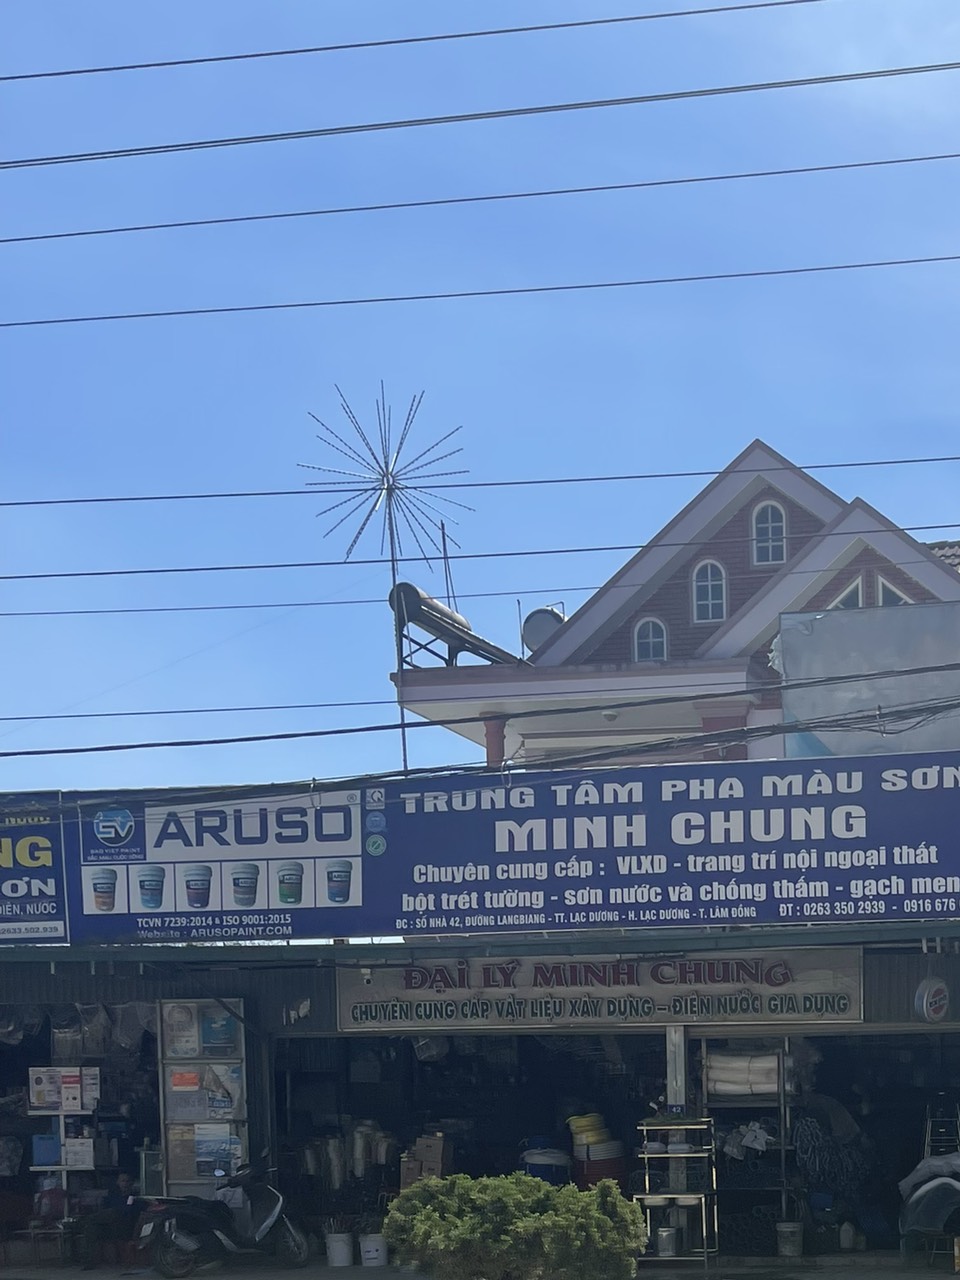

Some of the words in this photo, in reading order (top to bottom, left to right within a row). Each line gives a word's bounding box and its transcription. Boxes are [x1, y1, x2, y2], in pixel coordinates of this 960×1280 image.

[401, 787, 535, 814] TRUNG
[551, 780, 644, 806] TÂM
[662, 777, 744, 801] PHA
[763, 769, 863, 797] MÀU
[153, 806, 353, 849] ARUSO
[495, 815, 647, 853] MINH
[671, 805, 867, 845] CHUNG
[413, 862, 491, 883] Chuyên
[496, 862, 548, 880] cung
[554, 855, 594, 878] cấp
[616, 855, 667, 875] VLXD
[687, 854, 746, 873] trang
[752, 850, 777, 870] trí
[783, 848, 818, 872] nội
[825, 846, 887, 870] ngoại
[893, 841, 939, 865] thất
[402, 892, 436, 915] bột
[441, 890, 479, 909] trét
[484, 889, 545, 909] tường
[564, 886, 603, 906] sơn
[609, 883, 663, 904] nước
[667, 882, 693, 902] và
[700, 878, 768, 902] chống
[773, 876, 830, 898] thấm
[850, 875, 905, 899] gạch
[779, 904, 793, 920] ĐT
[803, 903, 831, 916] 0263
[834, 901, 855, 915] 350
[857, 900, 886, 914] 2939
[904, 899, 932, 912] 0916
[935, 898, 956, 911] 676
[137, 917, 162, 928] TCVN
[164, 915, 213, 927] 7239:2014
[222, 915, 241, 925] ISO
[242, 914, 292, 925] 9001:2015
[191, 926, 292, 938] ARUSOPAINT.COM
[395, 919, 409, 929] ĐC
[415, 914, 428, 928] SỐ
[429, 915, 448, 928] NHÀ
[465, 914, 495, 927] ĐƯỜNG
[497, 914, 546, 926] LANGBIANG
[554, 912, 568, 924] TT.
[570, 911, 587, 924] LẠC
[589, 910, 619, 923] DƯƠNG
[628, 910, 639, 922] H.
[640, 909, 657, 922] LẠC
[659, 908, 691, 921] DƯƠNG
[710, 905, 729, 918] LÂM
[481, 960, 523, 988] LÝ
[531, 962, 640, 988] MINH
[649, 959, 793, 987] CHUNG
[351, 998, 411, 1022] CHUYÊN
[414, 1000, 457, 1021] CUNG
[460, 994, 491, 1020] CẤP
[494, 993, 526, 1022] VẬT
[528, 993, 563, 1022] LIỆU
[568, 993, 602, 1018] XÂY
[606, 995, 655, 1020] DỰNG
[672, 991, 712, 1020] ĐIỆN
[716, 988, 762, 1015] NƯỚC
[767, 994, 801, 1014] GIA
[802, 994, 850, 1018] DỤNG
